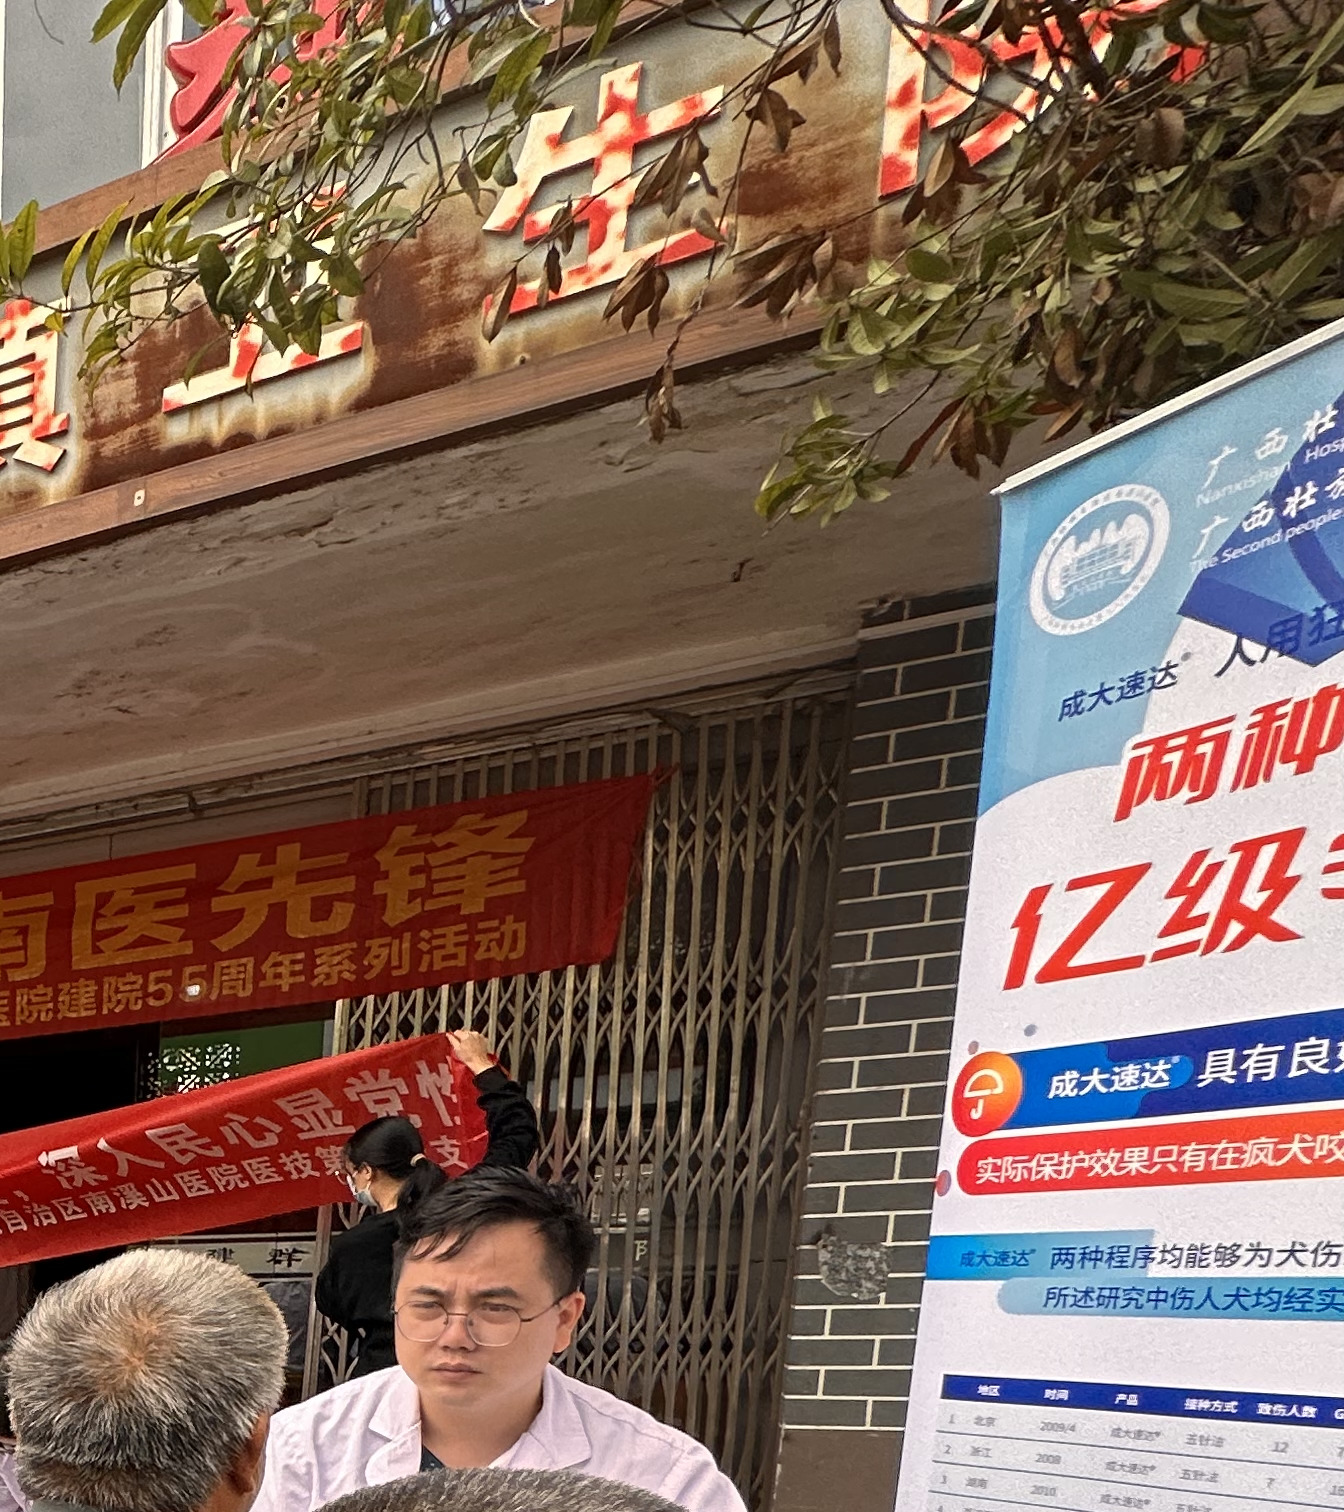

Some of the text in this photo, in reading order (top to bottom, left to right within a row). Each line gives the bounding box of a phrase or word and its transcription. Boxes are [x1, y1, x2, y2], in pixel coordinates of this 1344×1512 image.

[1221, 529, 1282, 565] Second
[1057, 660, 1179, 722] 成大速达
[1002, 826, 1344, 991] 亿级
[1048, 1059, 1173, 1099] 成大速达
